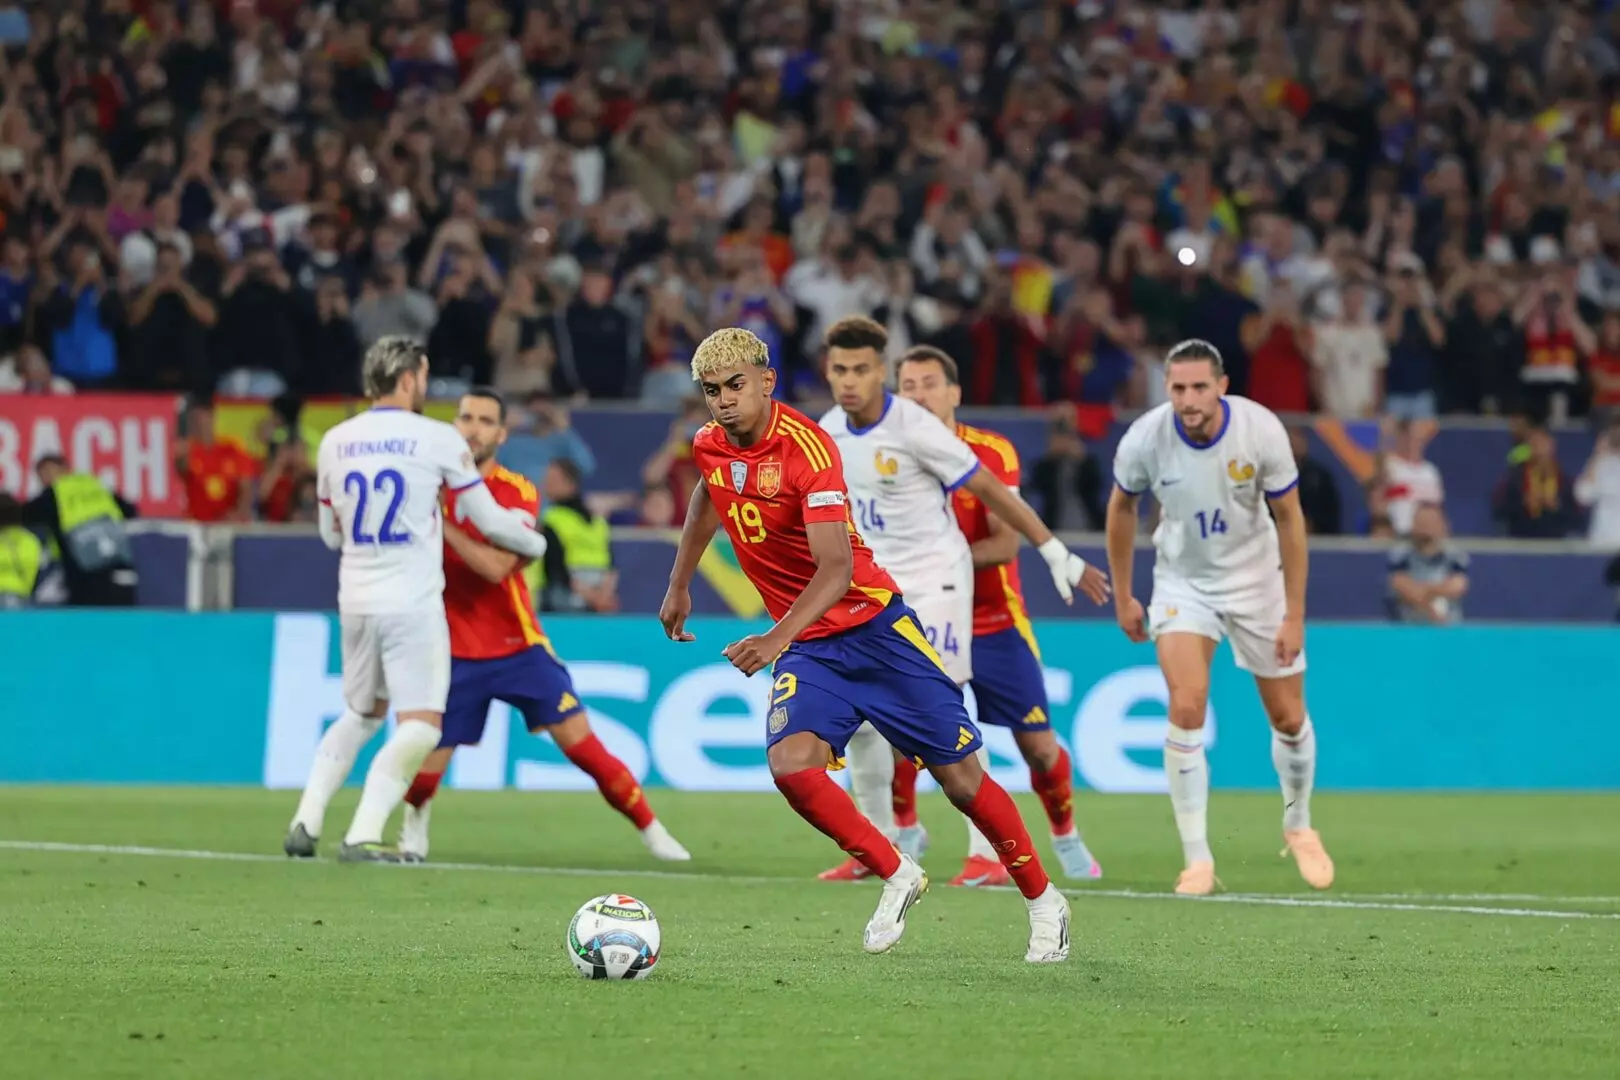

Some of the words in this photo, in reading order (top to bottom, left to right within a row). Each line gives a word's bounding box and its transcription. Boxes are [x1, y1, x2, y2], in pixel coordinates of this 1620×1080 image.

[344, 468, 410, 544] 22
[728, 501, 767, 544] 19
[857, 498, 885, 532] 24
[1194, 508, 1228, 539] 14
[768, 672, 797, 706] 9
